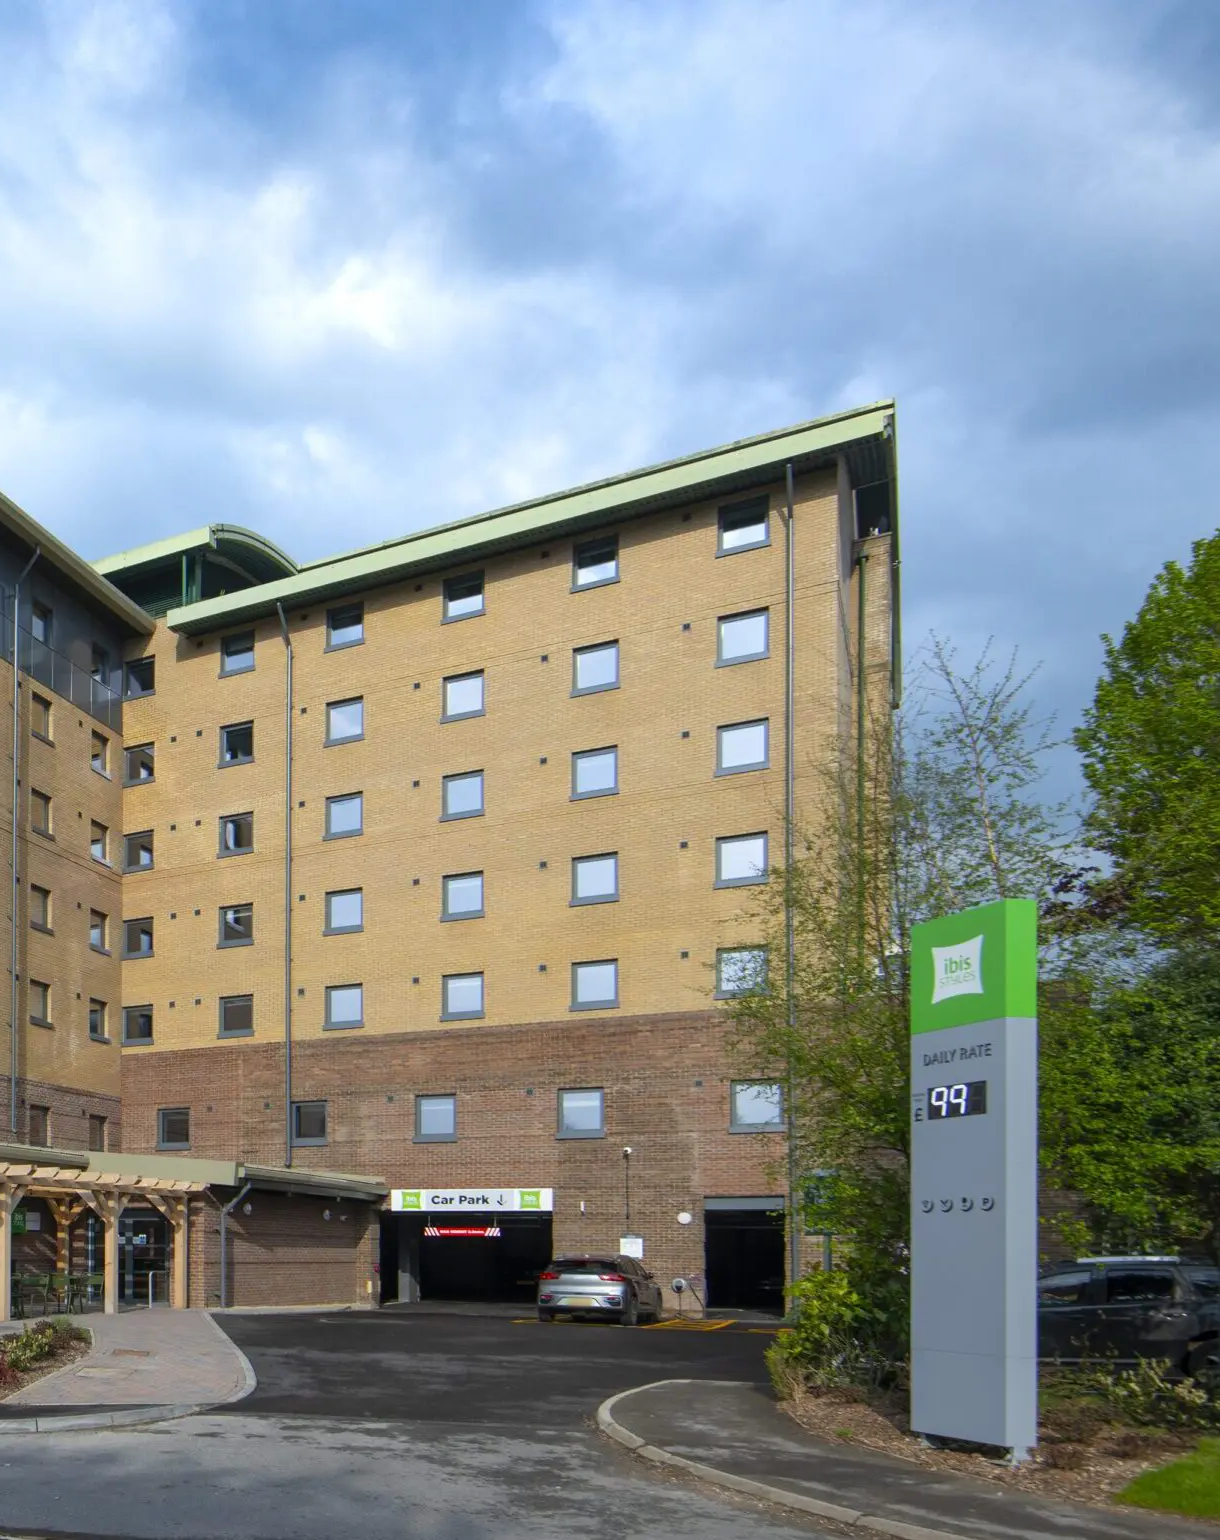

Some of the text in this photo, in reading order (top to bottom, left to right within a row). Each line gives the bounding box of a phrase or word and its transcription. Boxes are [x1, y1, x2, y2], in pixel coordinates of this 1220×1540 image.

[944, 955, 972, 975] ibis
[923, 1043, 992, 1066] DAILY RATE
[914, 1084, 967, 1122] £ 99
[431, 1195, 454, 1205] Car
[459, 1195, 489, 1205] Park
